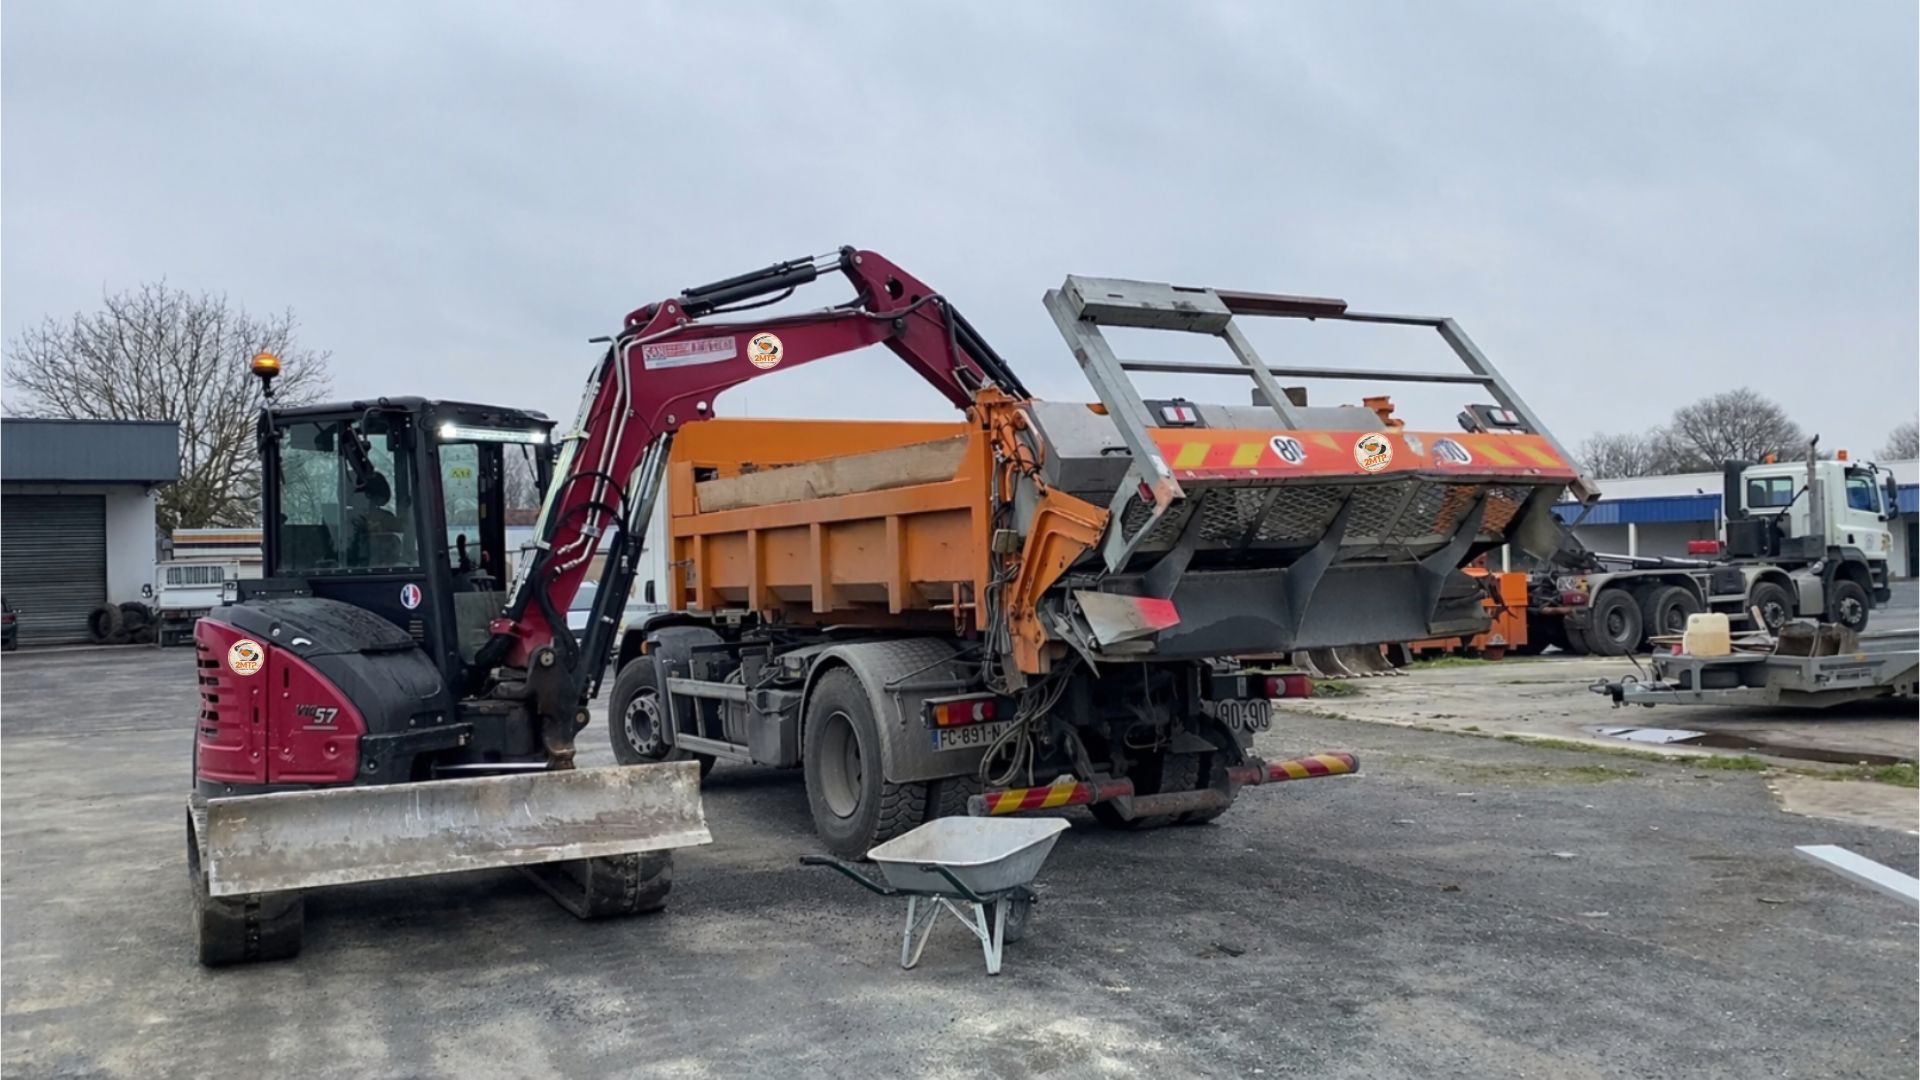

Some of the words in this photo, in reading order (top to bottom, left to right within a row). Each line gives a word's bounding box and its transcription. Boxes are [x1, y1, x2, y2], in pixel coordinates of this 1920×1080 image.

[1272, 437, 1305, 462] 80
[1364, 454, 1387, 466] 2MTP
[235, 661, 257, 669] 2MTP
[1249, 702, 1269, 728] 90
[940, 722, 1012, 747] FC-891-N
